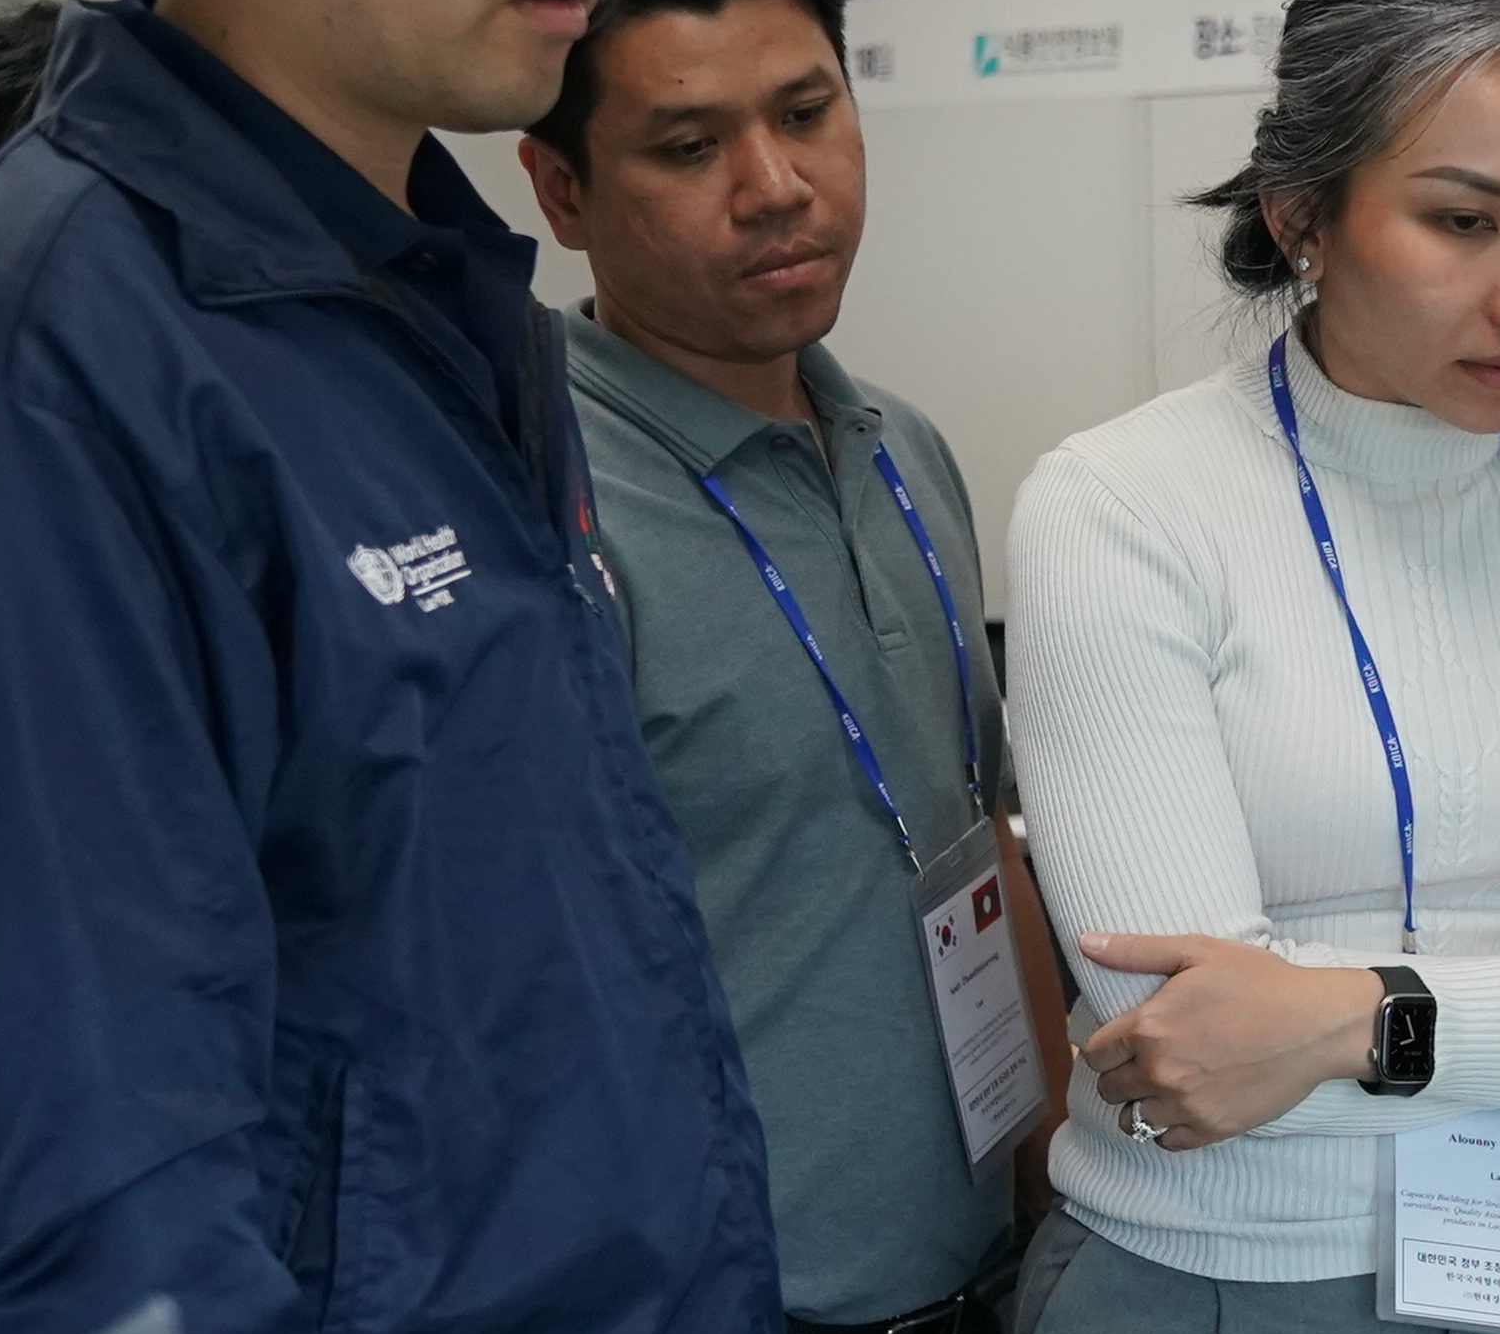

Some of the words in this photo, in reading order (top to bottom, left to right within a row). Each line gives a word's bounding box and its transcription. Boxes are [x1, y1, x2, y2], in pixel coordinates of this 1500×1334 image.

[1321, 541, 1338, 570] KOICA
[764, 563, 786, 592] KOICA
[1363, 661, 1381, 694] KOICA
[841, 713, 860, 742] KOICA
[1387, 735, 1403, 768] KOICA
[1449, 1134, 1497, 1150] Alounny
[1400, 1189, 1436, 1201] Capacity
[1437, 1192, 1470, 1206] Building
[1470, 1197, 1484, 1208] for
[1443, 1217, 1476, 1228] products
[1453, 1207, 1482, 1218] Quality
[1417, 1252, 1457, 1267] 대한민국
[1461, 1258, 1481, 1270] 정부
